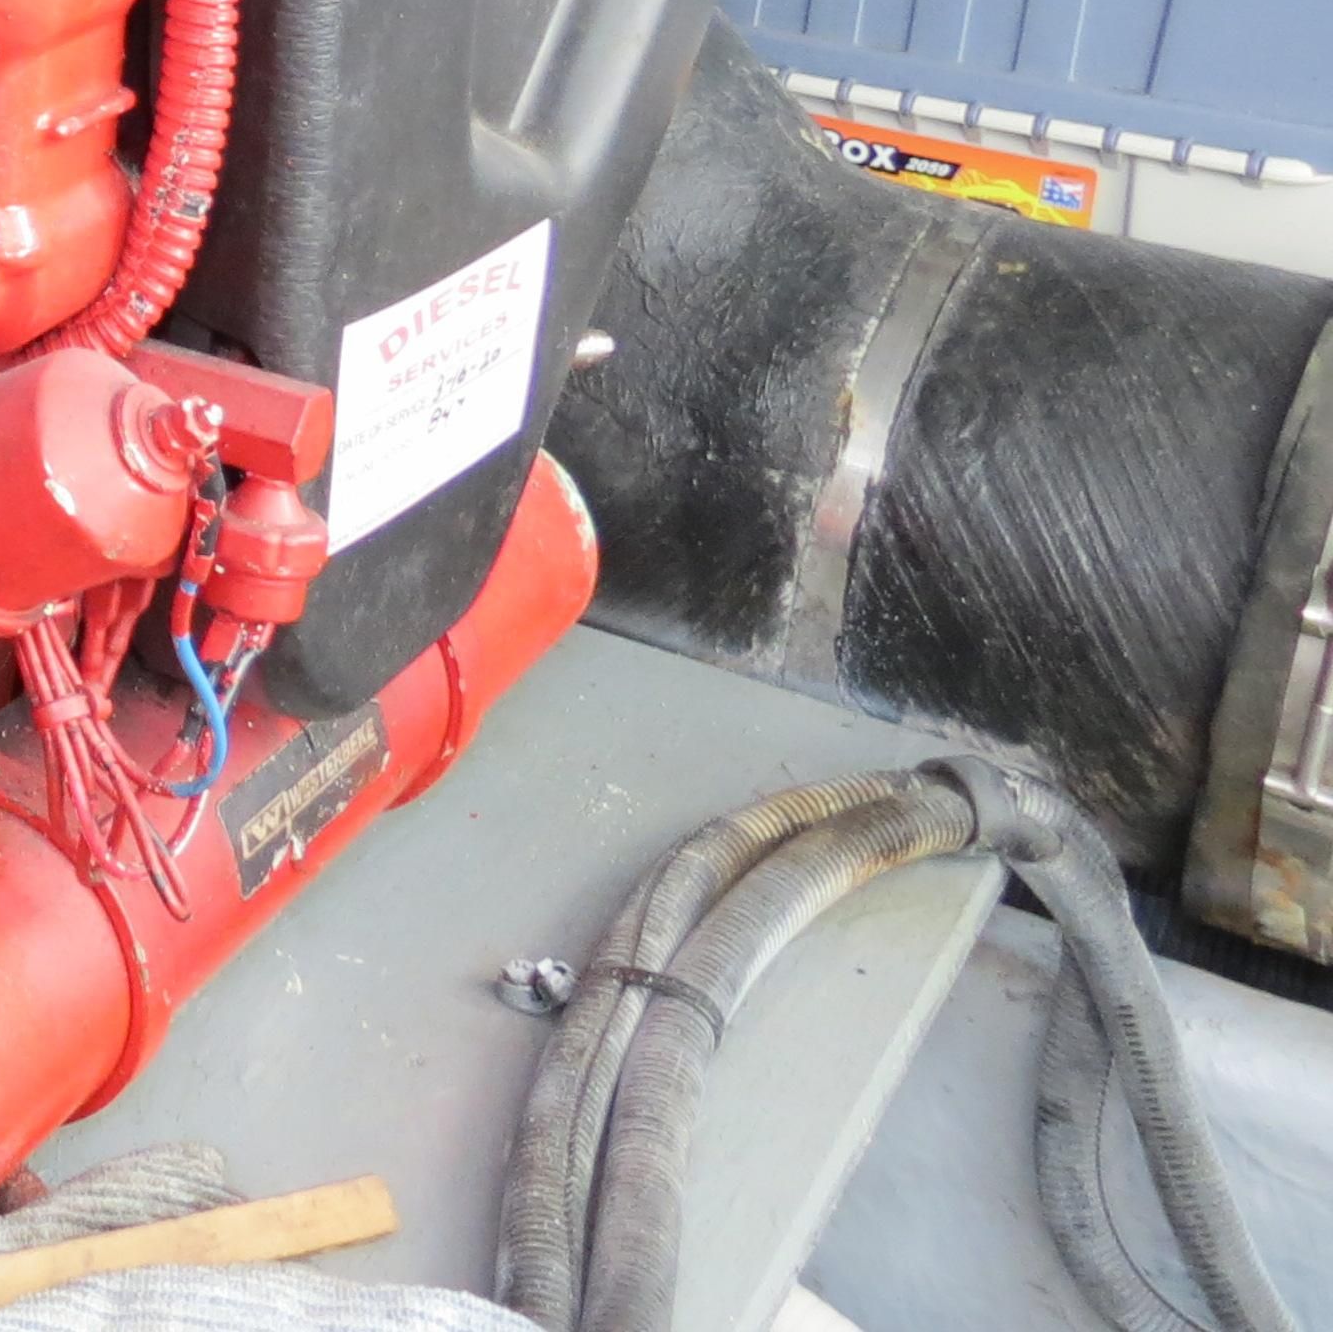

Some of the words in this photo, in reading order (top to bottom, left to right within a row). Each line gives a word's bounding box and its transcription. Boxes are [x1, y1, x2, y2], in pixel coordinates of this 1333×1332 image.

[904, 157, 952, 177] 2059
[378, 260, 522, 364] DIESEL
[386, 311, 509, 393] SERVICES
[287, 717, 378, 810] WESTERBEKE
